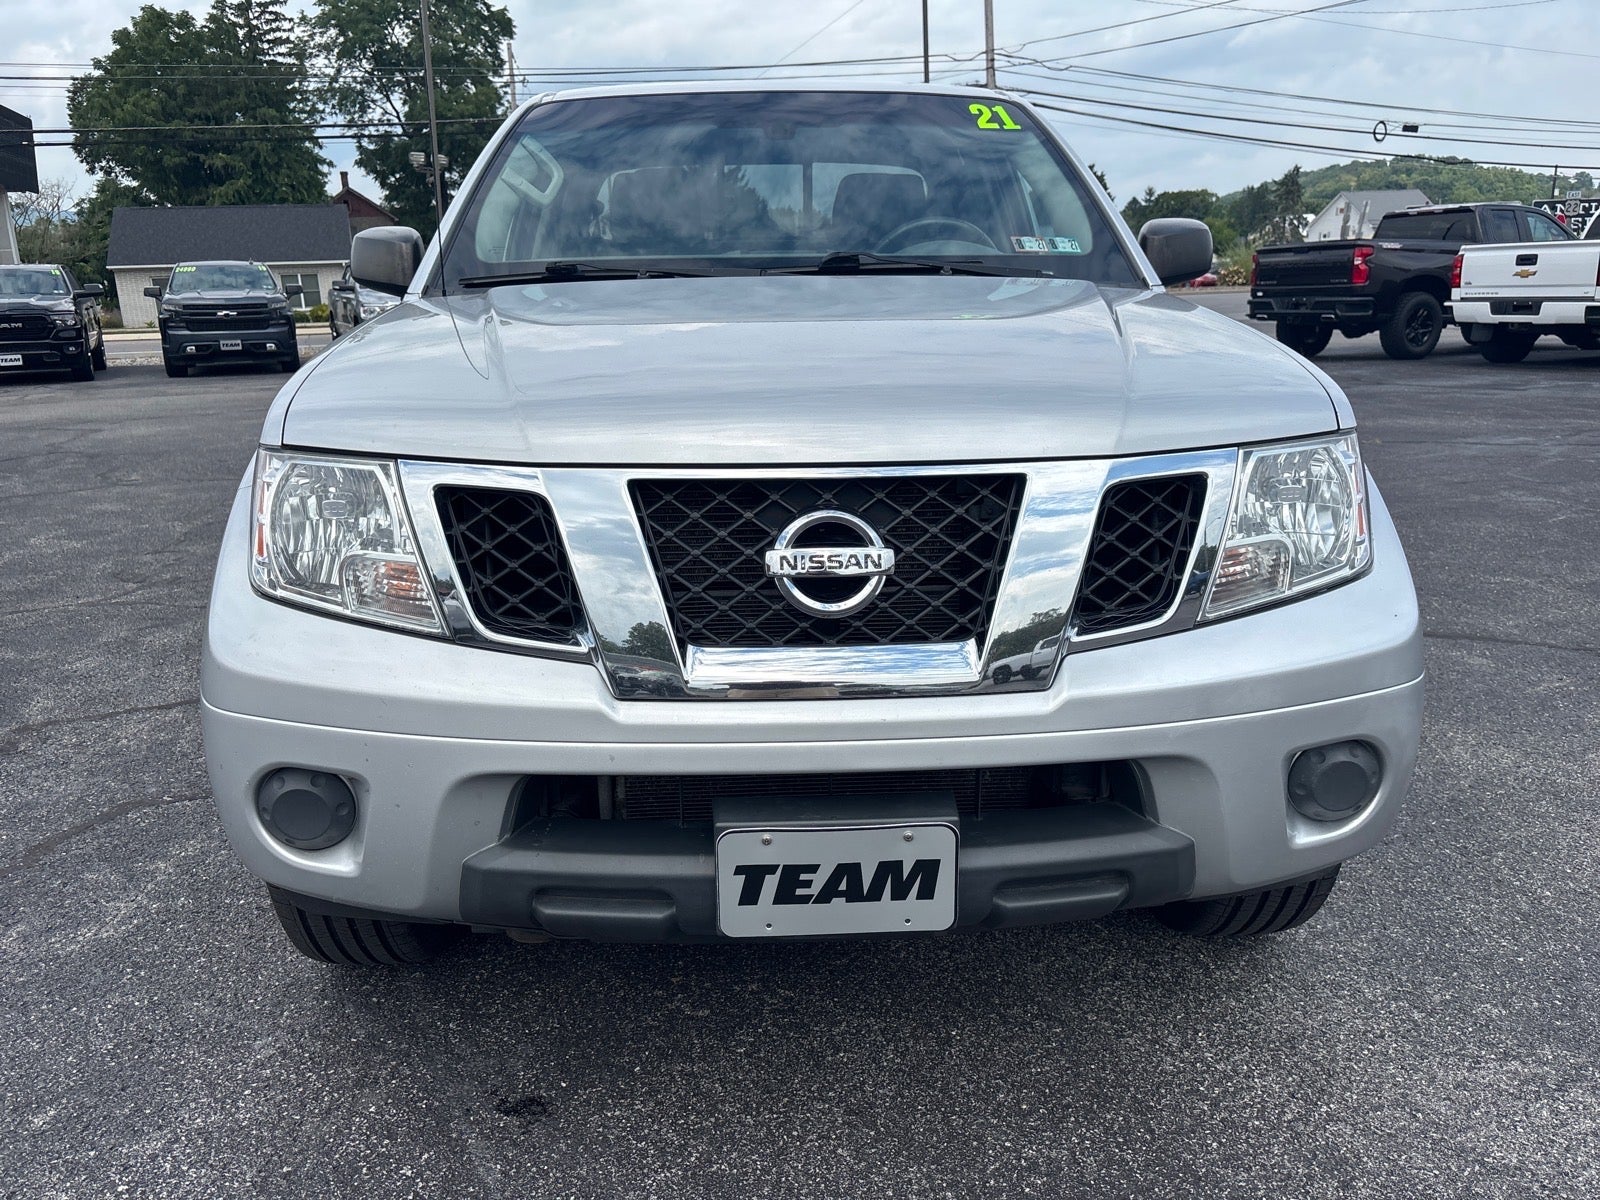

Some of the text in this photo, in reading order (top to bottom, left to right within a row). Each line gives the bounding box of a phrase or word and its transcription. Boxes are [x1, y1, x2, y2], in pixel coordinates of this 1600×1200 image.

[969, 103, 1021, 129] 21
[1565, 203, 1579, 213] 22
[779, 553, 883, 571] NISSAN
[733, 858, 942, 906] TEAM
